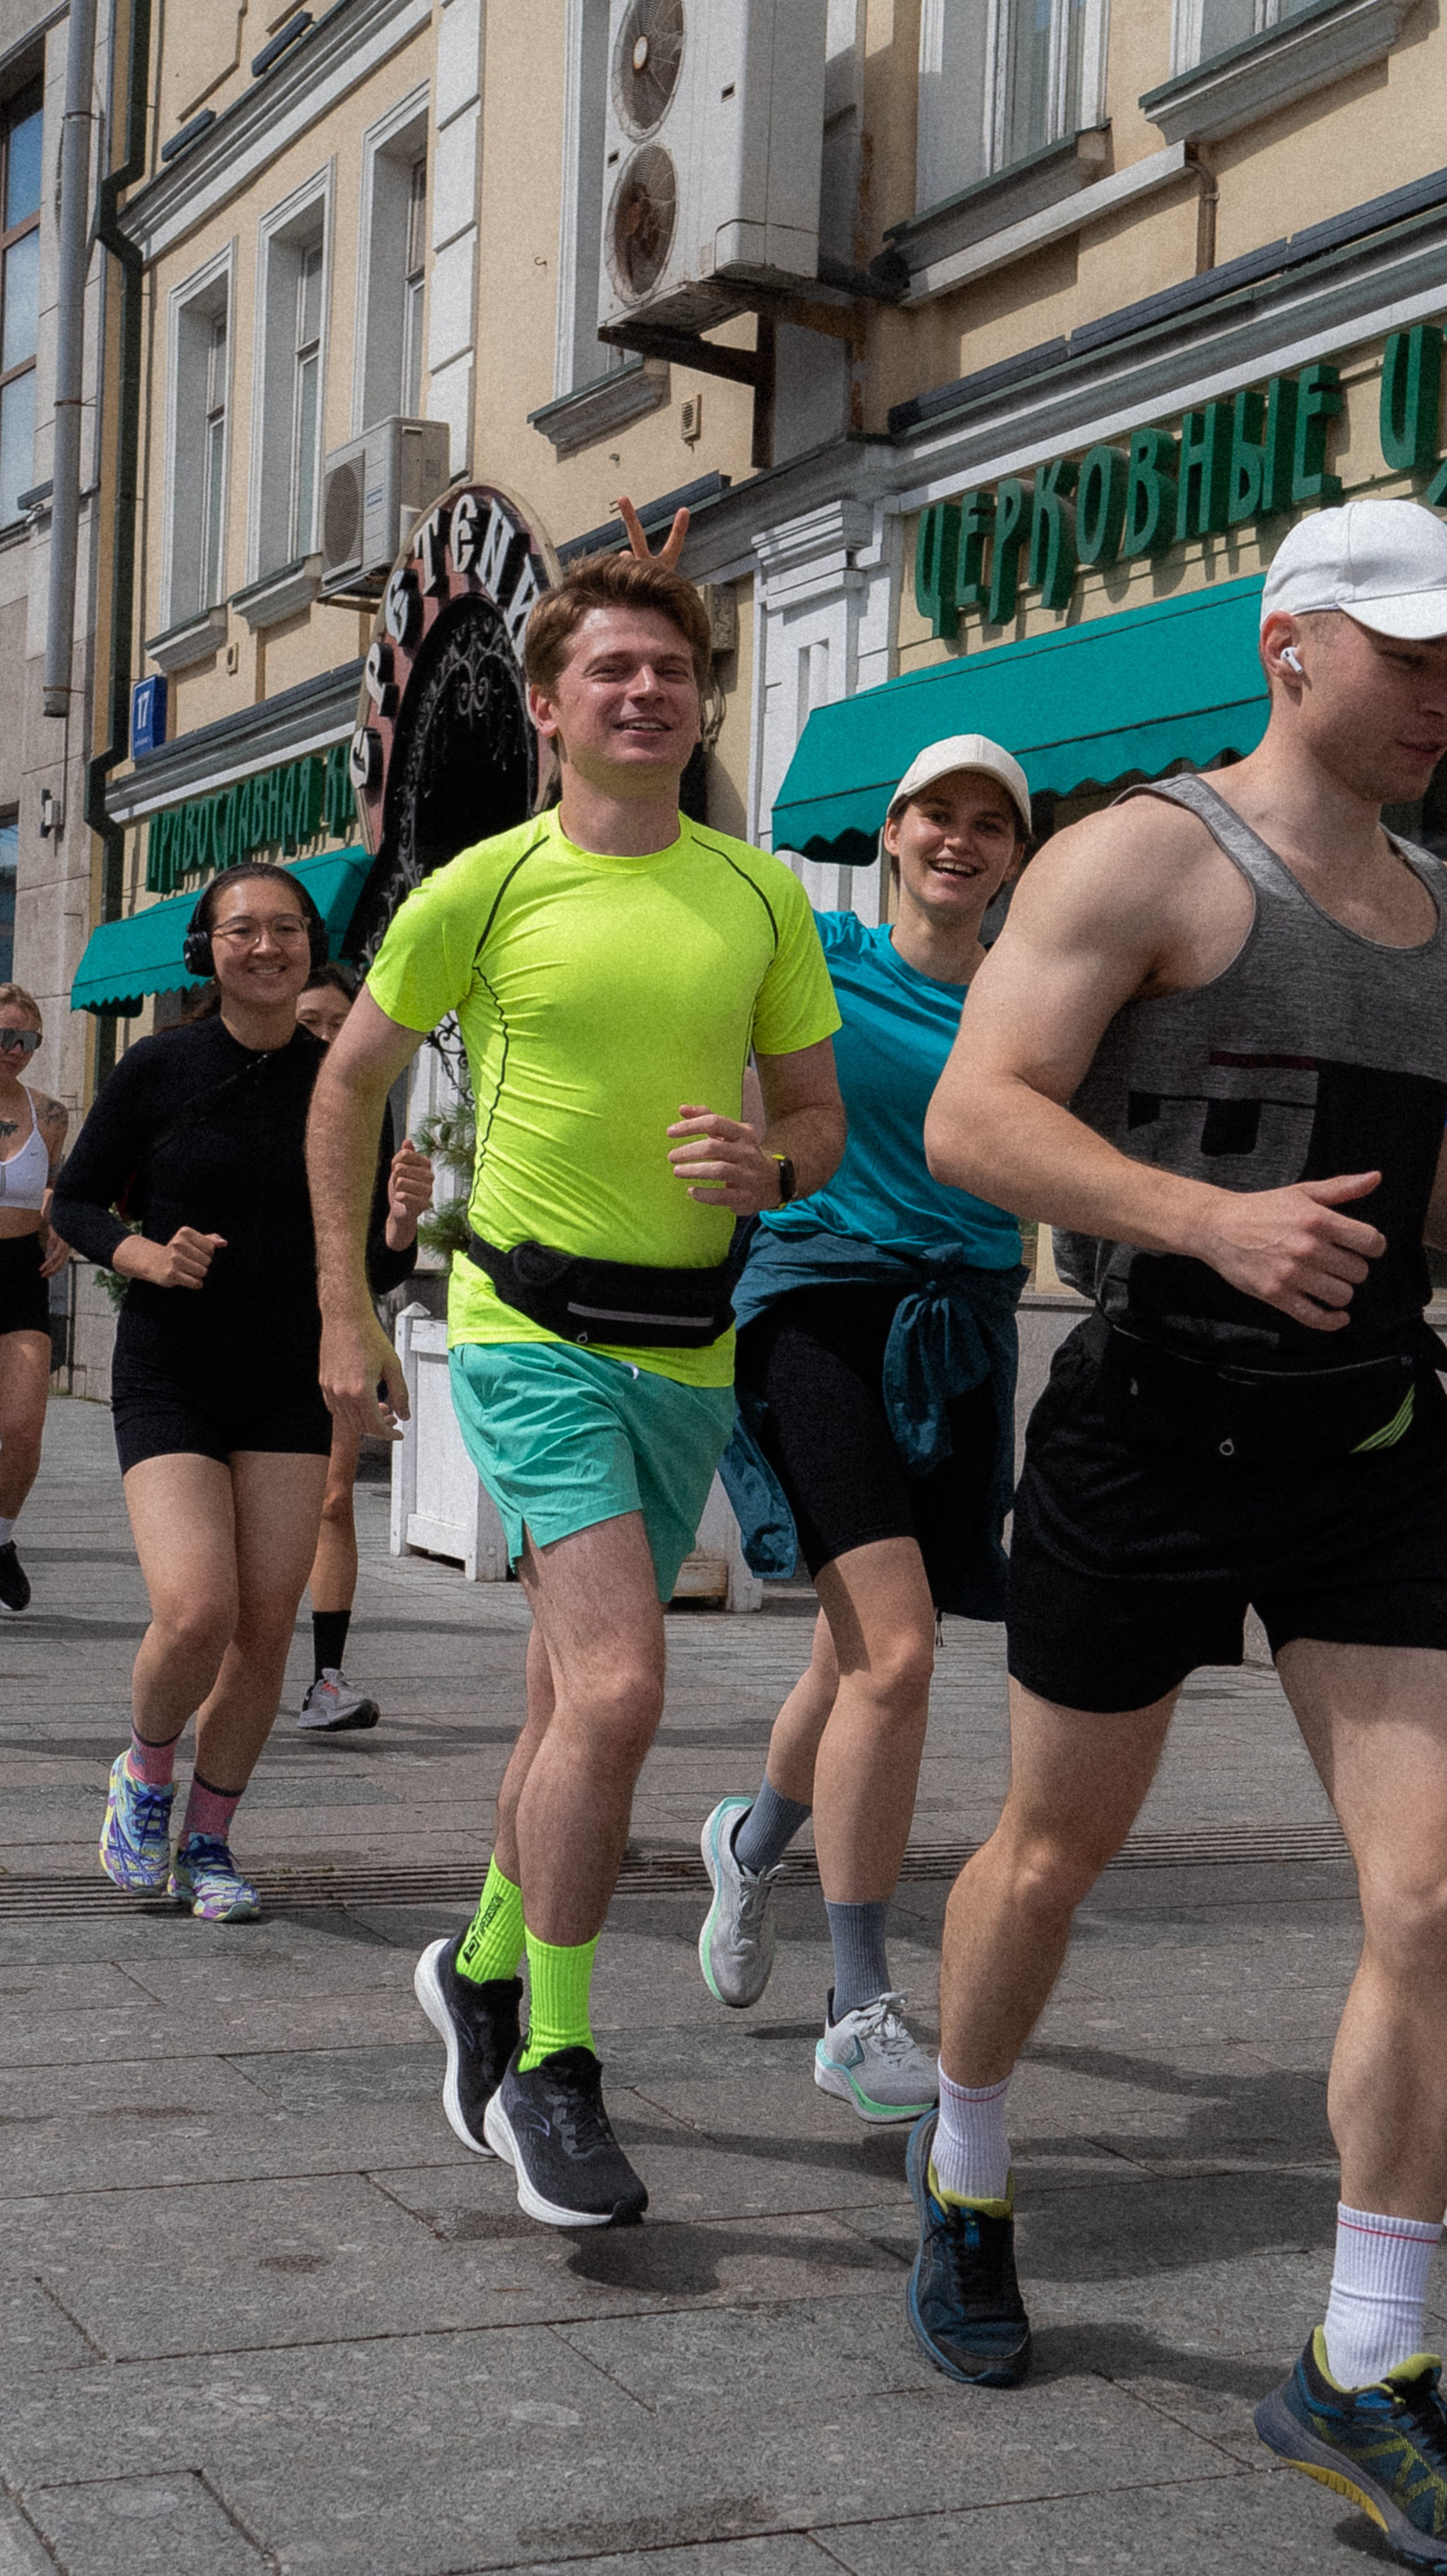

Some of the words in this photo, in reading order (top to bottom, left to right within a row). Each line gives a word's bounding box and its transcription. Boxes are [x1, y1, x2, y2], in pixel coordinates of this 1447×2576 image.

[914, 364, 1342, 639] ЦЕРКОВНЫЕ
[137, 690, 151, 731] 17
[146, 756, 323, 895] ПРАВОСЛАВНАЯ
